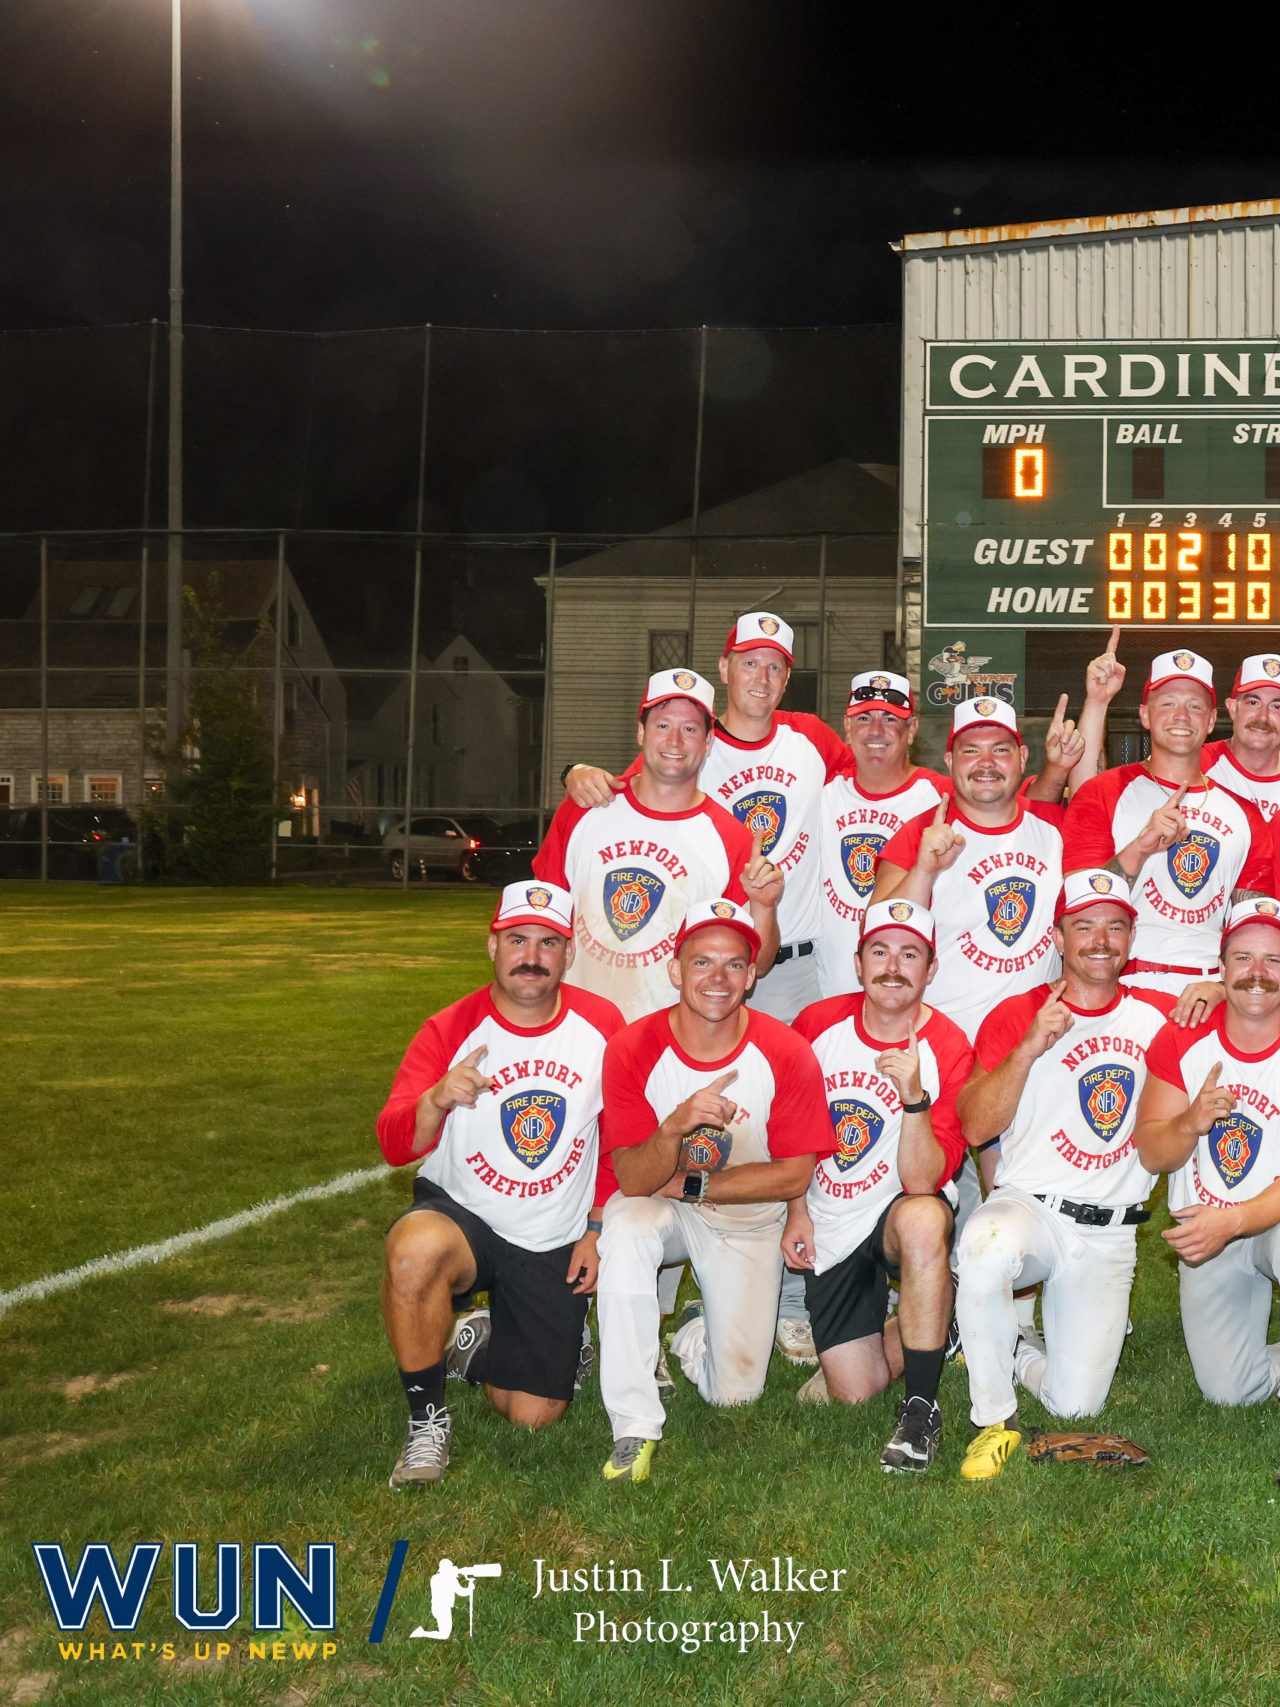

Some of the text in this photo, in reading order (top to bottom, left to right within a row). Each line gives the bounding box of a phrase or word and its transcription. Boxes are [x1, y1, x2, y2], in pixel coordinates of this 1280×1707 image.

[982, 424, 1046, 444] MPH
[1116, 424, 1183, 444] BALL
[1014, 448, 1044, 497] 0
[1116, 512, 1125, 528] 1
[1148, 512, 1163, 528] 2
[1183, 512, 1197, 528] 3
[1218, 512, 1232, 528] 4
[1253, 512, 1266, 528] 5
[973, 539, 1094, 565] GUEST
[987, 588, 1094, 613] HOME
[718, 766, 797, 799] NEWPORT
[737, 798, 755, 812] FIRE
[844, 837, 861, 846] FIRE
[598, 840, 688, 880] NEWPORT
[968, 852, 1048, 885] NEWPORT
[611, 872, 634, 882] FIRE
[989, 884, 1007, 897] FIRE
[1061, 1036, 1146, 1072] NEWPORT
[489, 1060, 583, 1096] NEWPORT
[1083, 1071, 1103, 1086] FIRE
[505, 1095, 561, 1111] FIRE DEPT.
[834, 1103, 855, 1113] FIRE
[521, 1116, 544, 1139] NFD
[466, 1138, 585, 1198] FIREFIGHTERS
